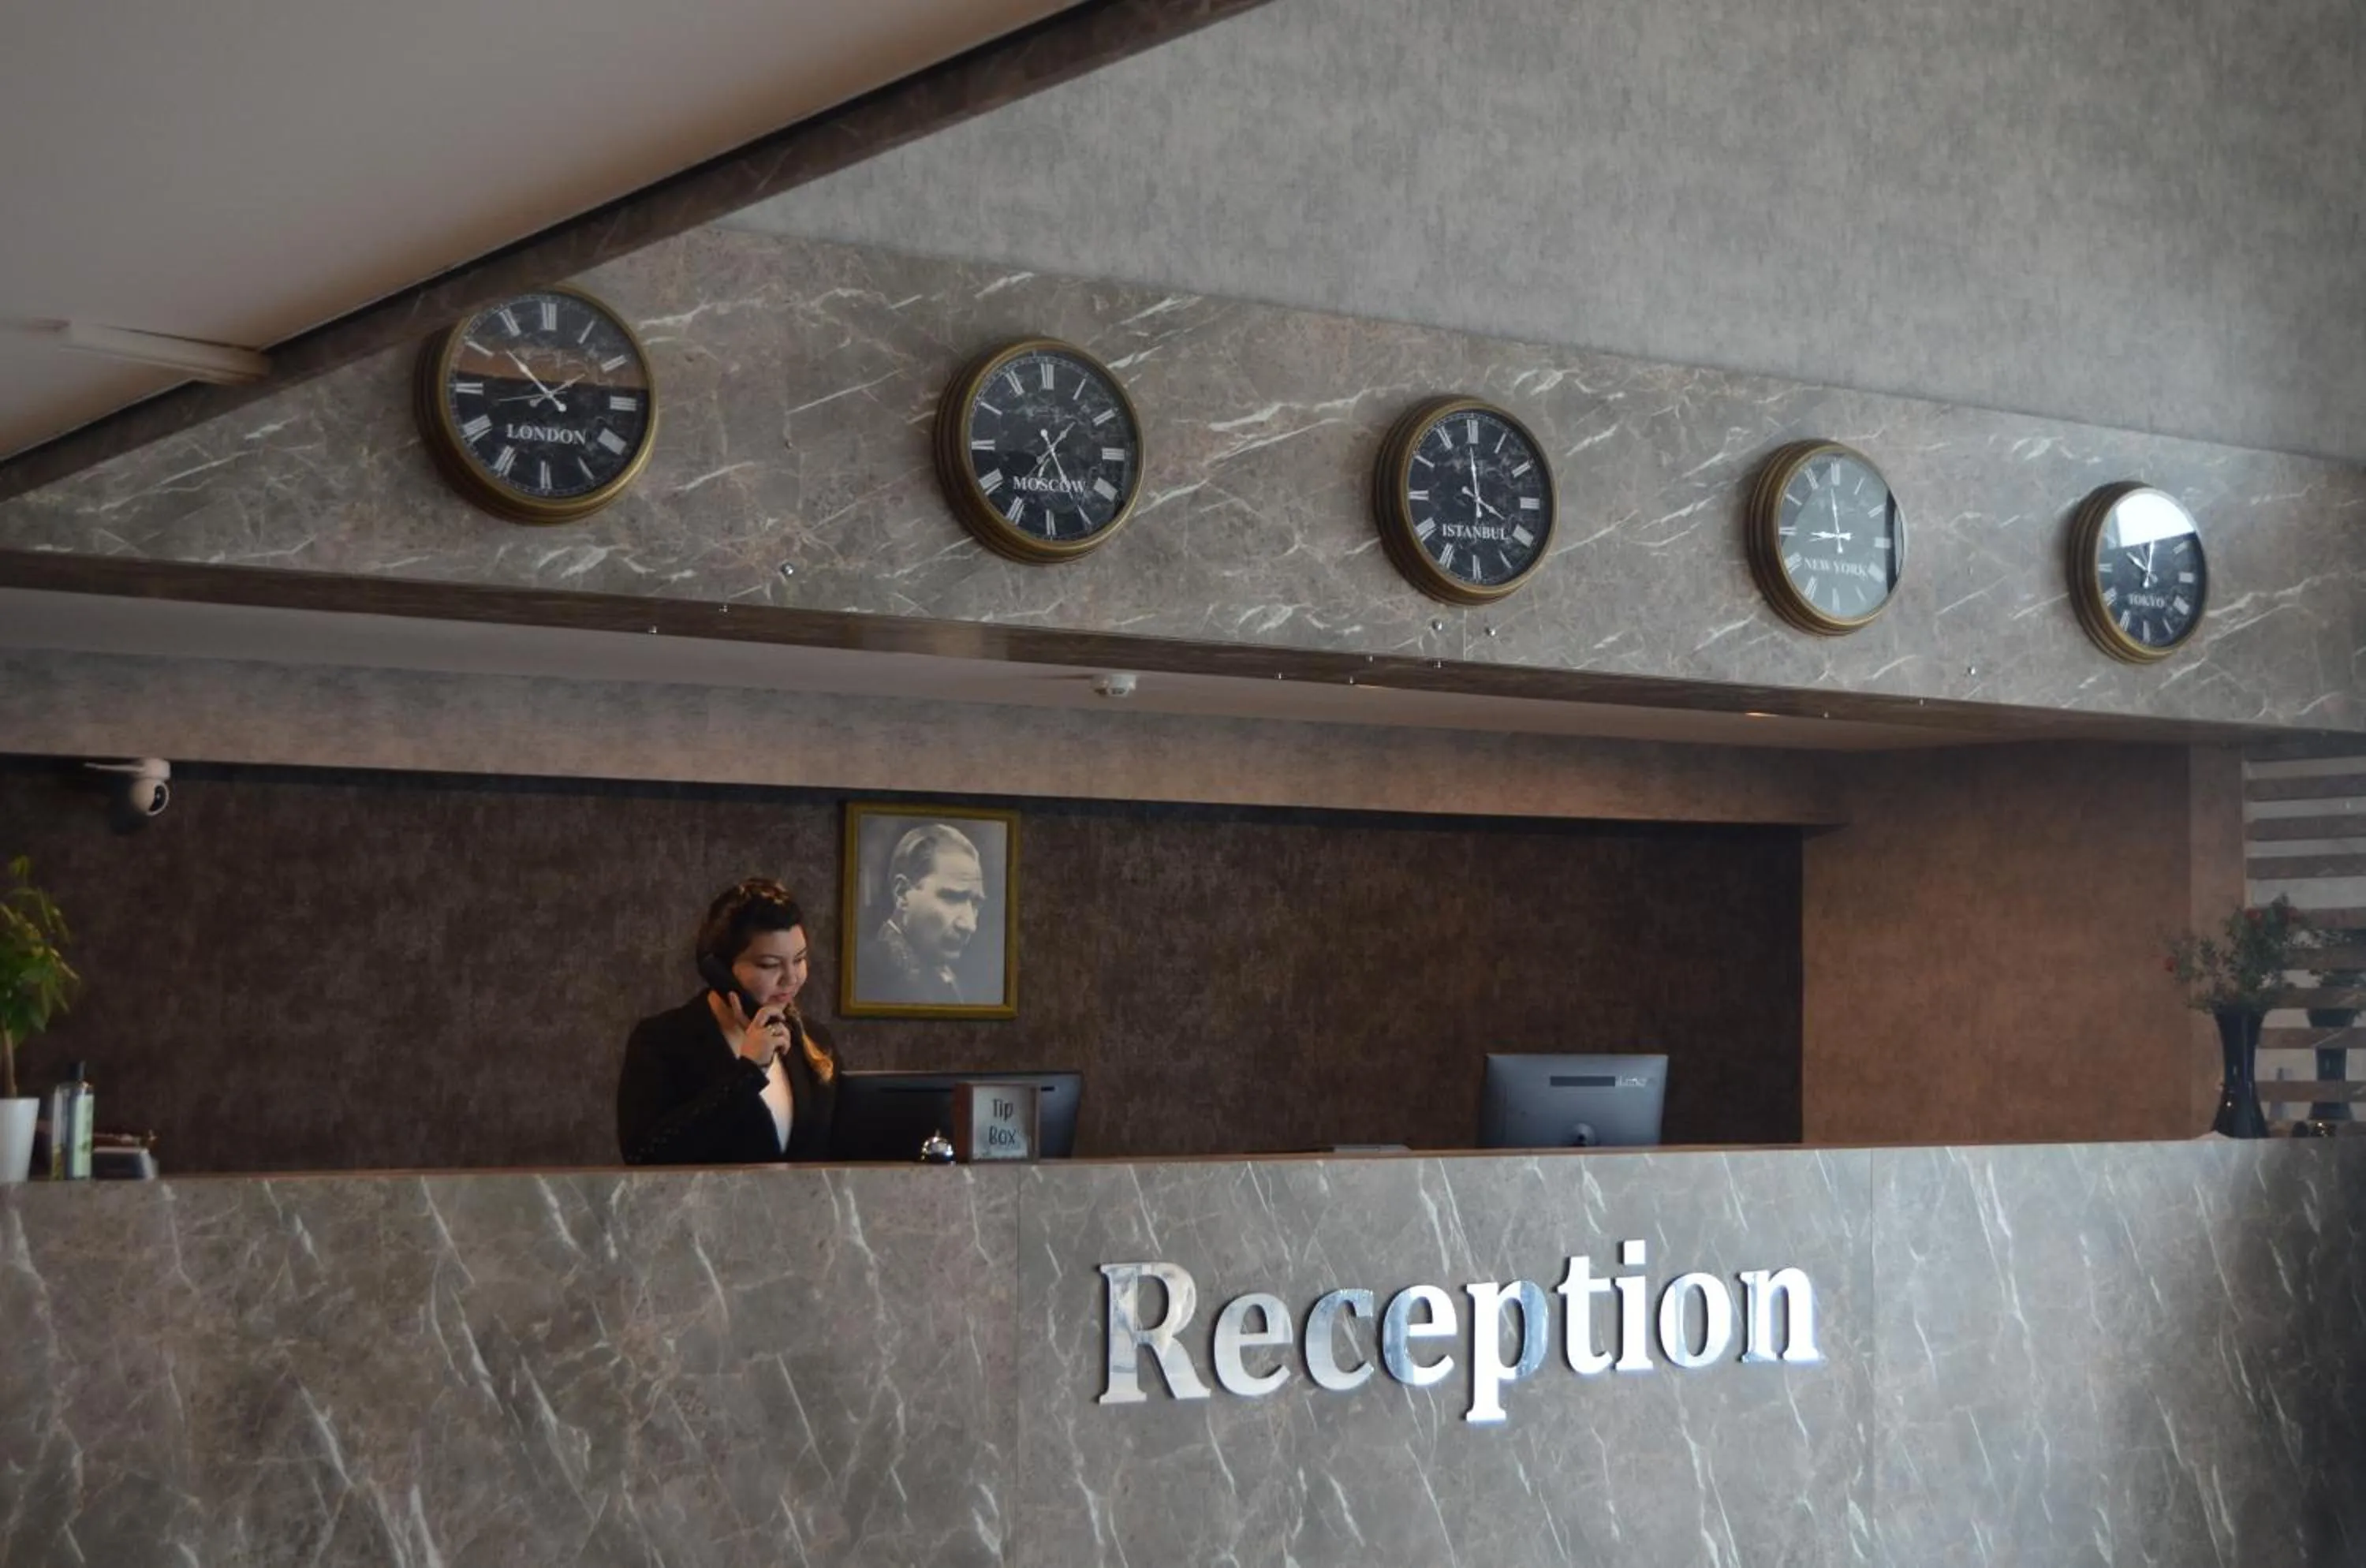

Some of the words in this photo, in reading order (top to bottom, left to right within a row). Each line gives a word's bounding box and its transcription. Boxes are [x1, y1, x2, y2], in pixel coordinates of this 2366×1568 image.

[506, 423, 587, 445] LONDON
[1013, 475, 1087, 494] MOSCOW
[1442, 523, 1510, 540] ISTANBUL
[1803, 557, 1830, 572] NEW
[1833, 560, 1869, 580] YORK
[2128, 593, 2166, 608] TOKYO
[991, 1097, 1014, 1123] Tip
[1095, 1239, 1823, 1424] Reception
